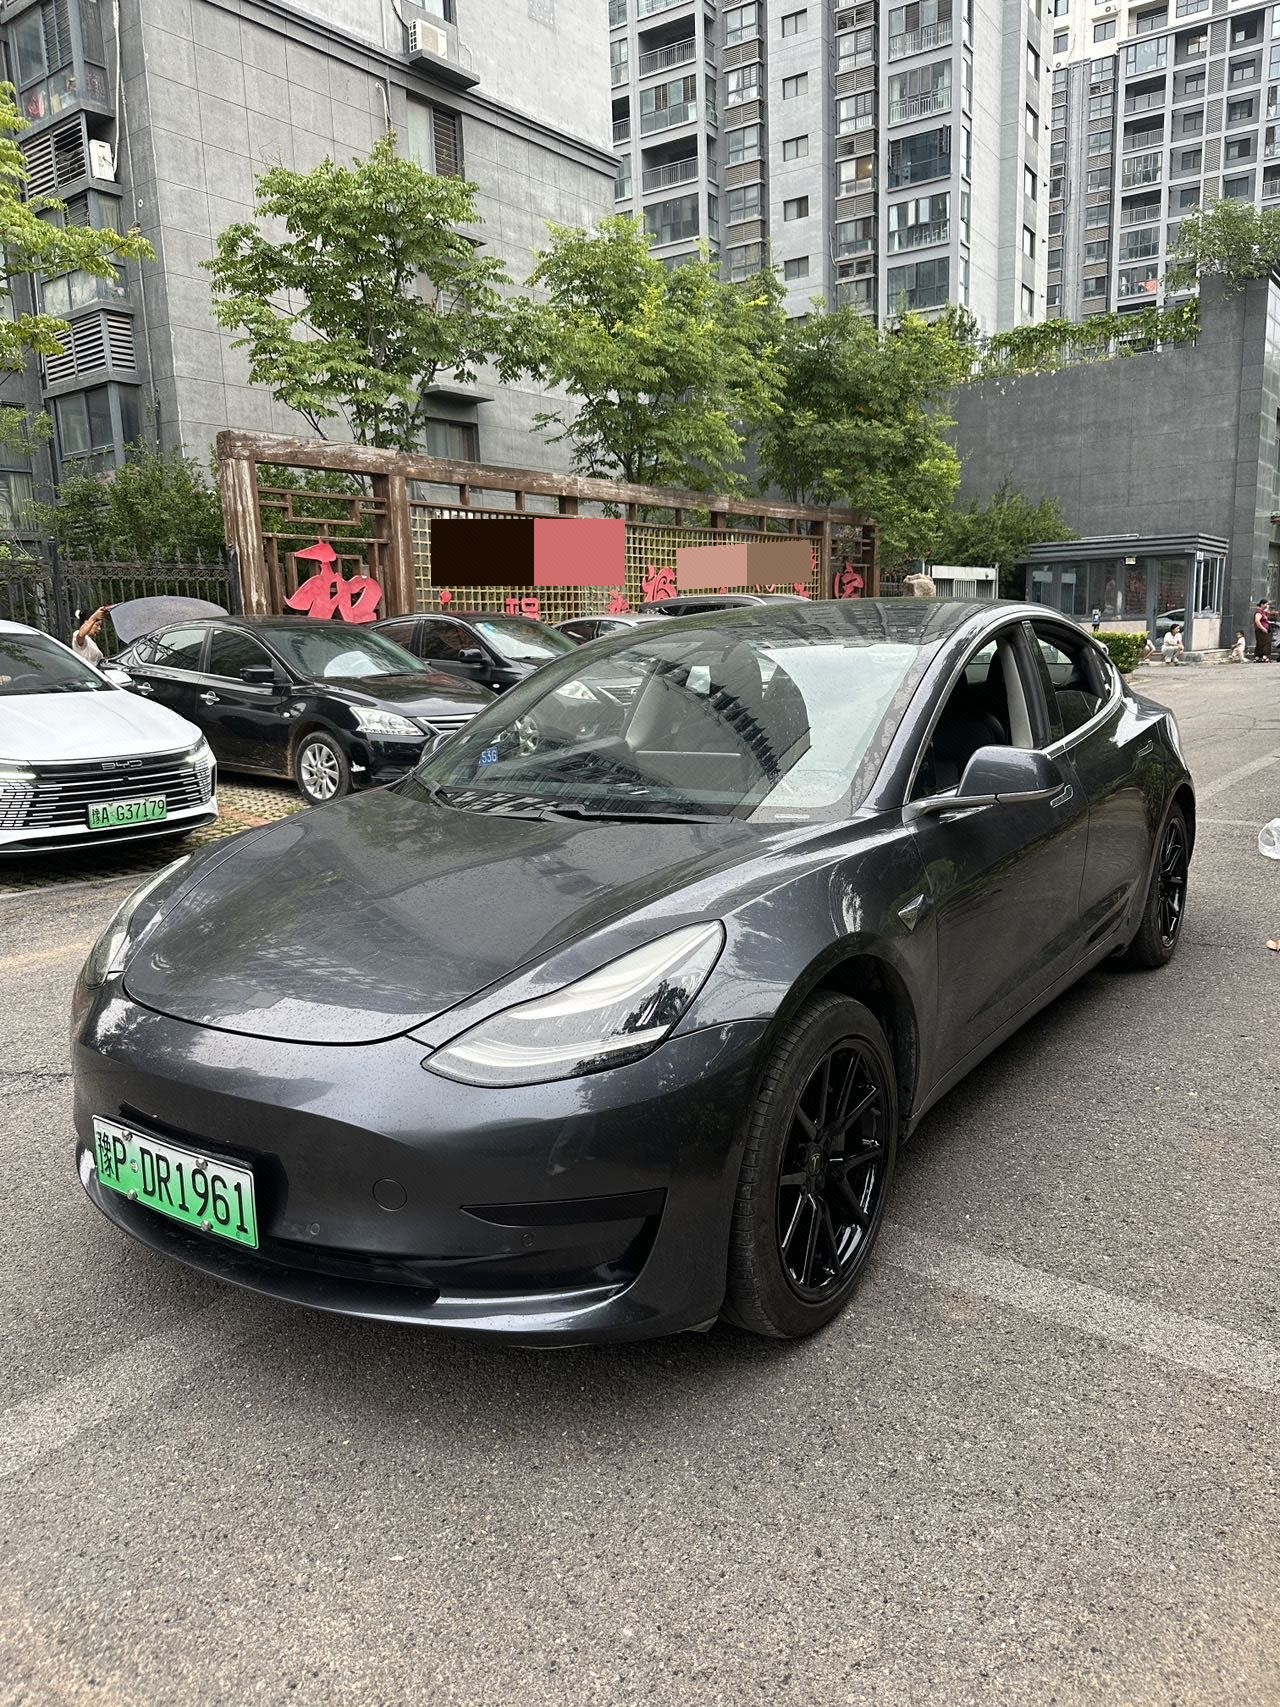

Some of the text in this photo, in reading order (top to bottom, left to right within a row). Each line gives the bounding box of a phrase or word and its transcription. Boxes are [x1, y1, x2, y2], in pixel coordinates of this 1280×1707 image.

[101, 759, 143, 771] BYD
[116, 799, 165, 821] G37179
[95, 1131, 249, 1235] 豫P DR1961
